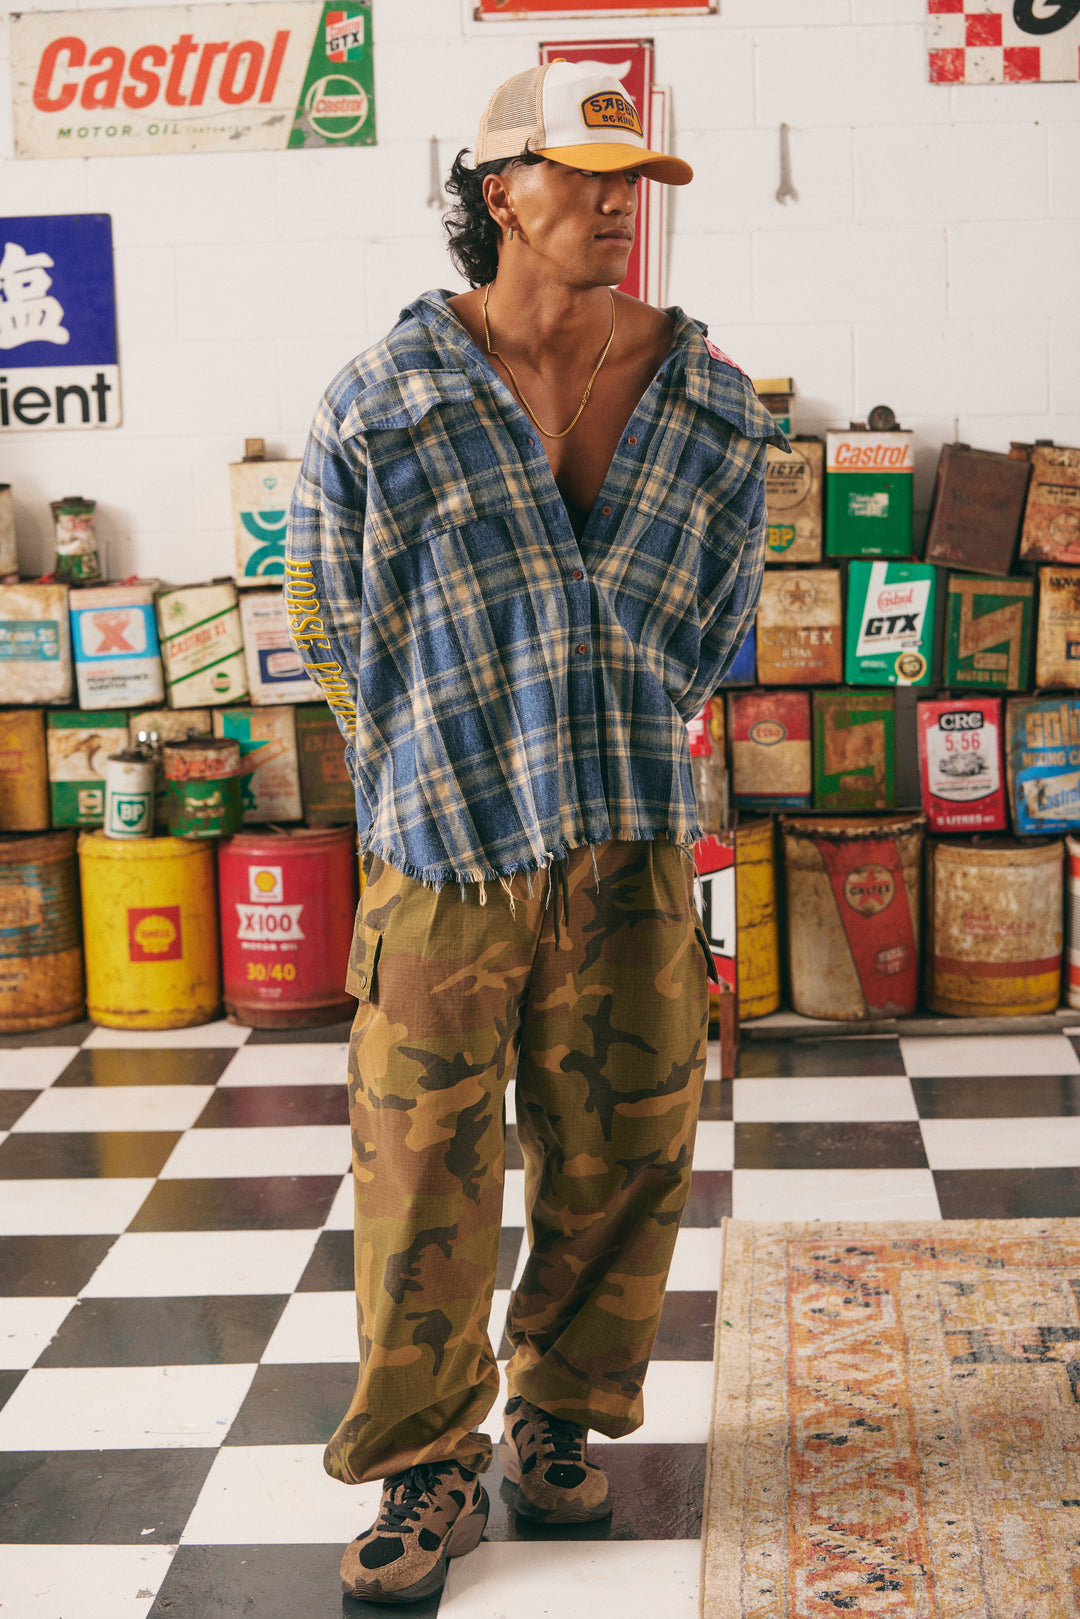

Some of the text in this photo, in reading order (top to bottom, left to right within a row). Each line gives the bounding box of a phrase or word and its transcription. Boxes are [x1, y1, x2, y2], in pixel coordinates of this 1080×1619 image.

[328, 31, 359, 51] GTX
[33, 30, 290, 112] Castrol
[58, 125, 132, 139] MOTOR
[147, 123, 179, 136] OIL
[0, 373, 111, 427] ient
[835, 443, 909, 466] Castrol
[768, 527, 794, 546] BP
[284, 557, 331, 650] HORSE
[865, 613, 920, 637] GTX
[762, 630, 833, 645] CALTEX
[304, 661, 356, 736] POWE
[941, 712, 982, 730] CRC
[1022, 751, 1066, 767] MIXING
[120, 804, 144, 820] BP
[849, 884, 890, 895] CALTEX
[246, 962, 296, 981] 30/40
